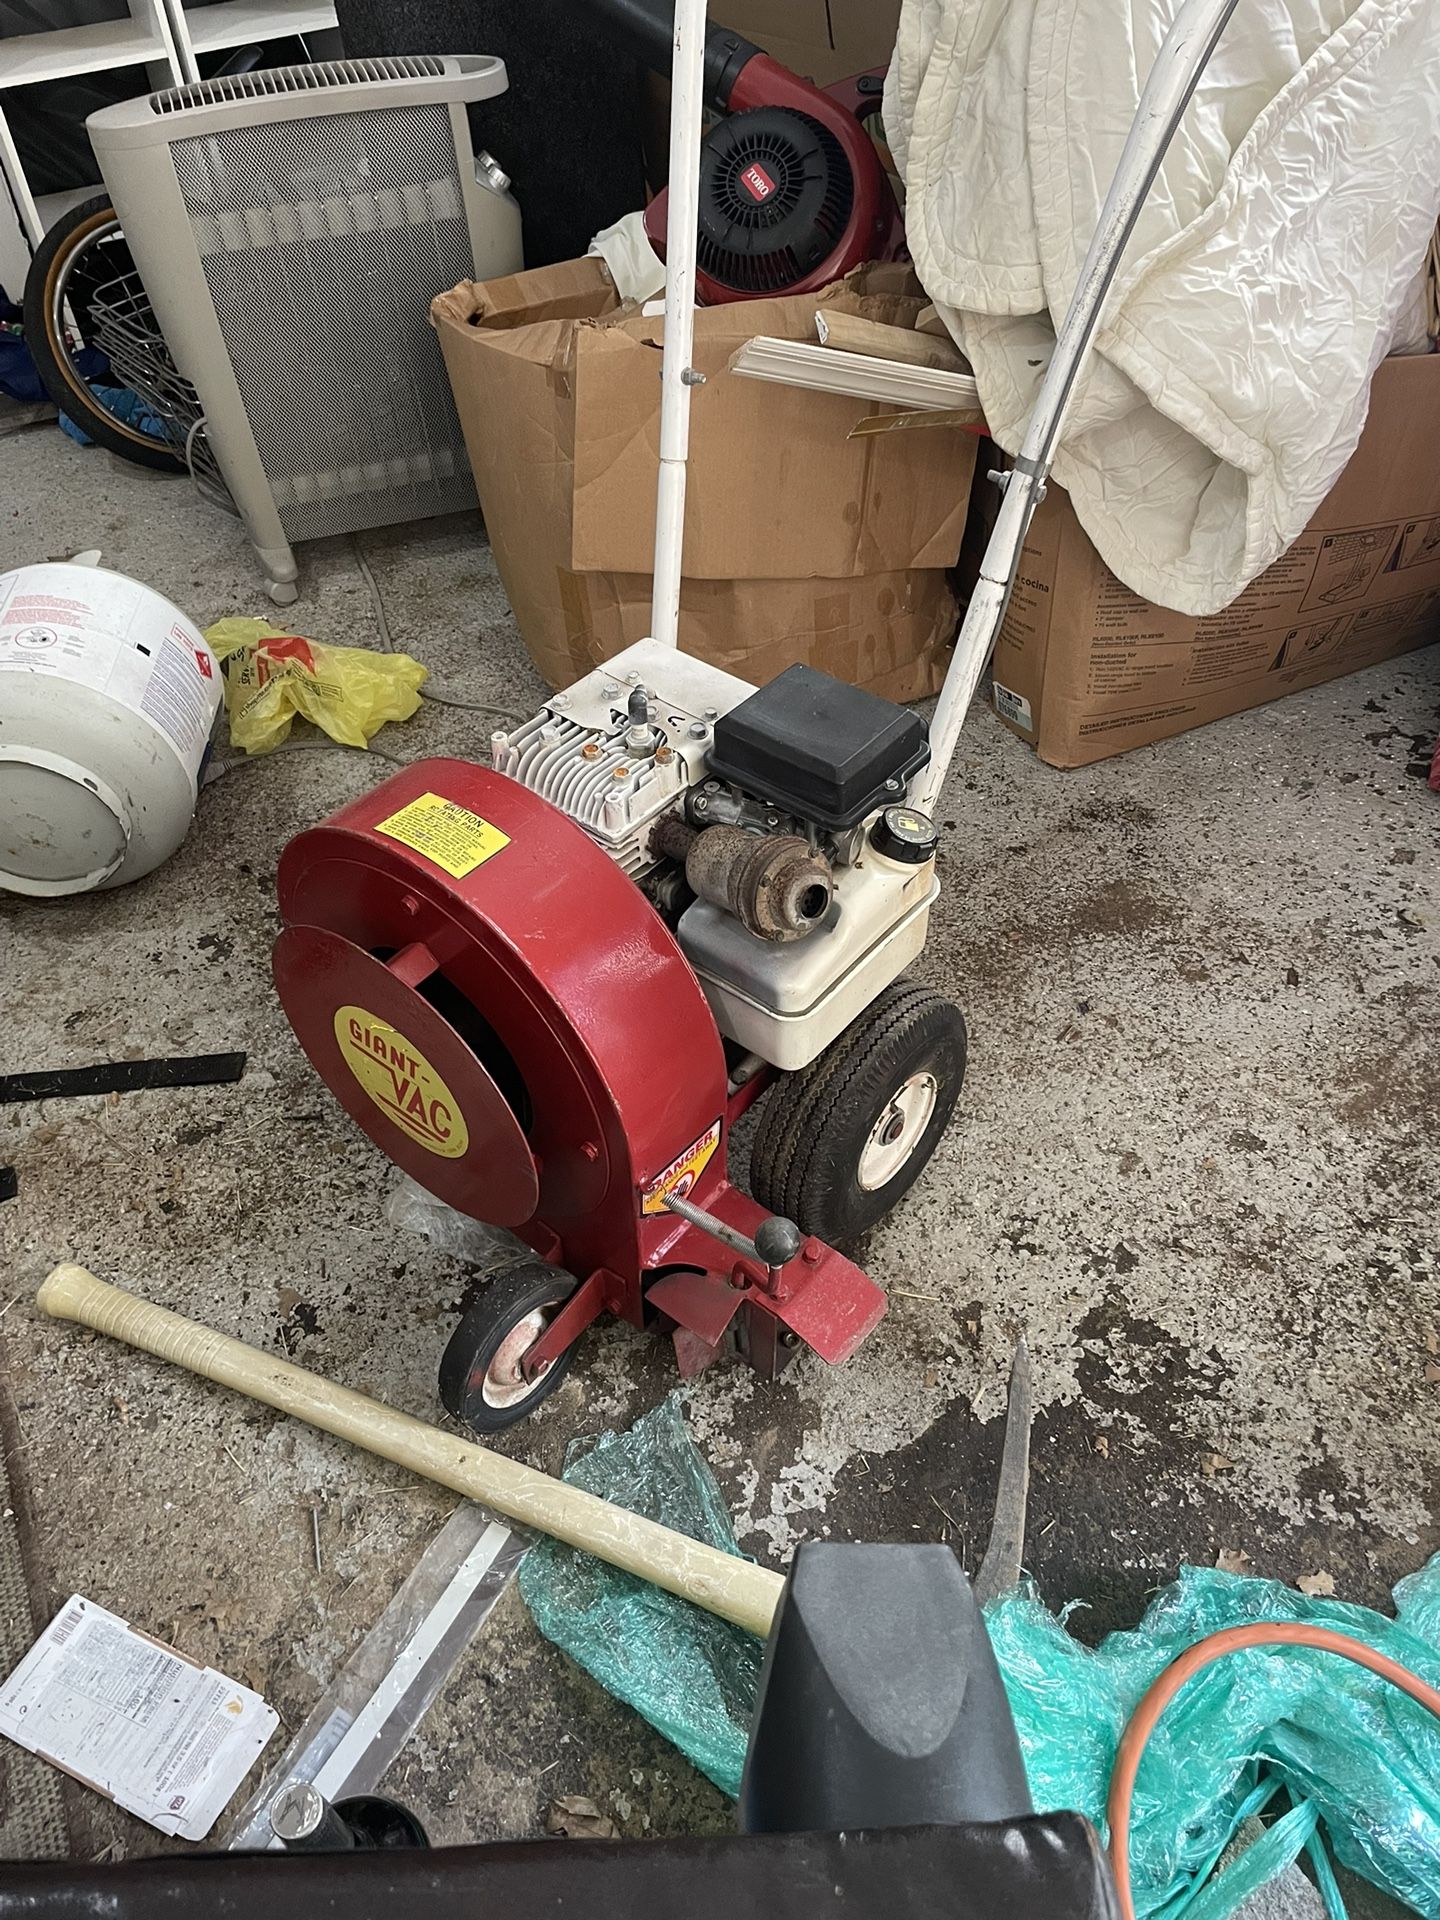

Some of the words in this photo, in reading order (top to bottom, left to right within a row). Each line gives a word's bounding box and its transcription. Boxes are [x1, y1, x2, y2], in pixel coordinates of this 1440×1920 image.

[747, 168, 769, 196] TORO
[1021, 576, 1049, 593] cocina
[429, 805, 461, 825] ROTATING
[460, 819, 484, 838] PARTS
[443, 802, 484, 828] CAUTION
[390, 1069, 452, 1138] VAC
[646, 1130, 713, 1192] DANGER
